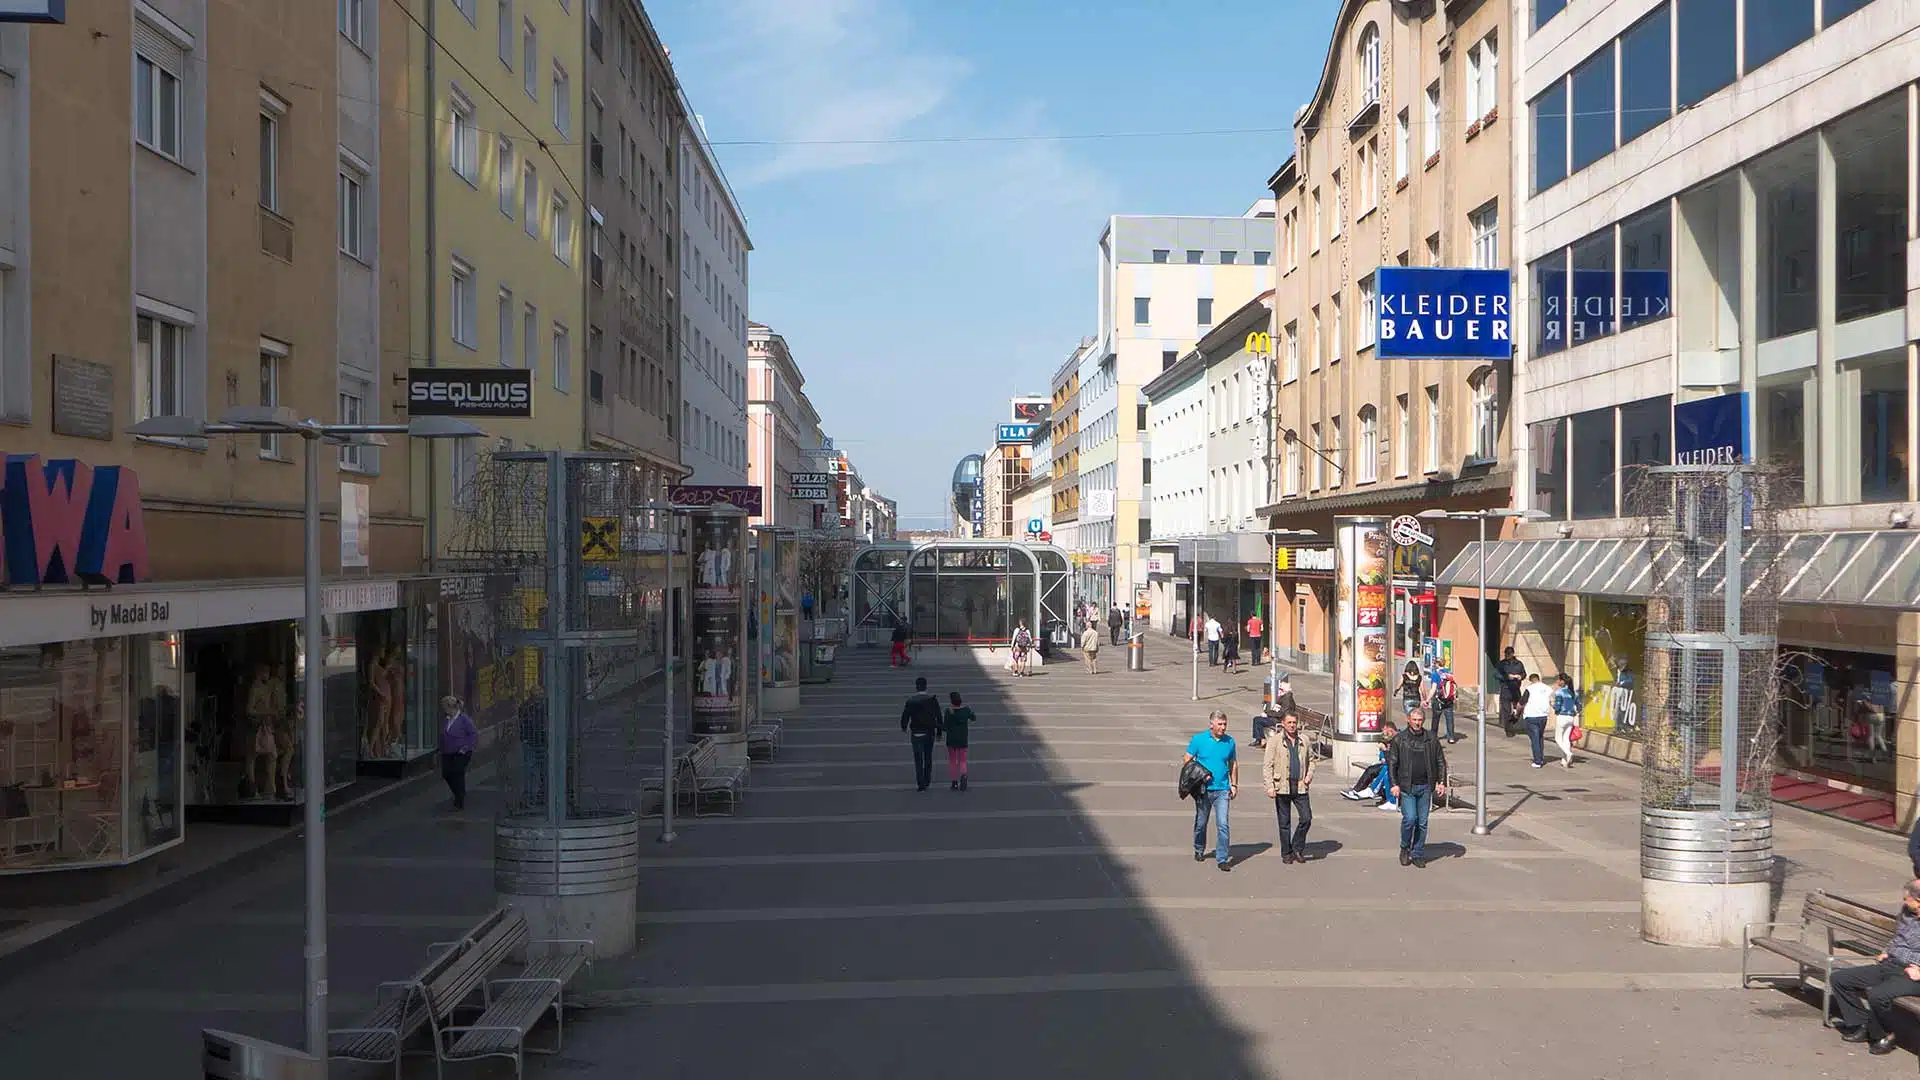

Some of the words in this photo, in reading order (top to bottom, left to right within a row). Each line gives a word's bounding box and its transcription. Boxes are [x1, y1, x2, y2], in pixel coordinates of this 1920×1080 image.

[1381, 295, 1508, 315] KLEIDER
[1381, 319, 1508, 340] BAUER
[411, 382, 528, 407] SEQUINS
[1001, 428, 1033, 437] TLAP
[1678, 445, 1734, 466] KLEIDER
[792, 473, 827, 483] PELZE
[671, 487, 712, 504] GOLD
[714, 488, 761, 506] STYLE
[792, 489, 827, 498] LEDER
[1031, 521, 1041, 532] U
[91, 606, 107, 630] by
[111, 604, 148, 623] Madal
[152, 602, 170, 621] Bal
